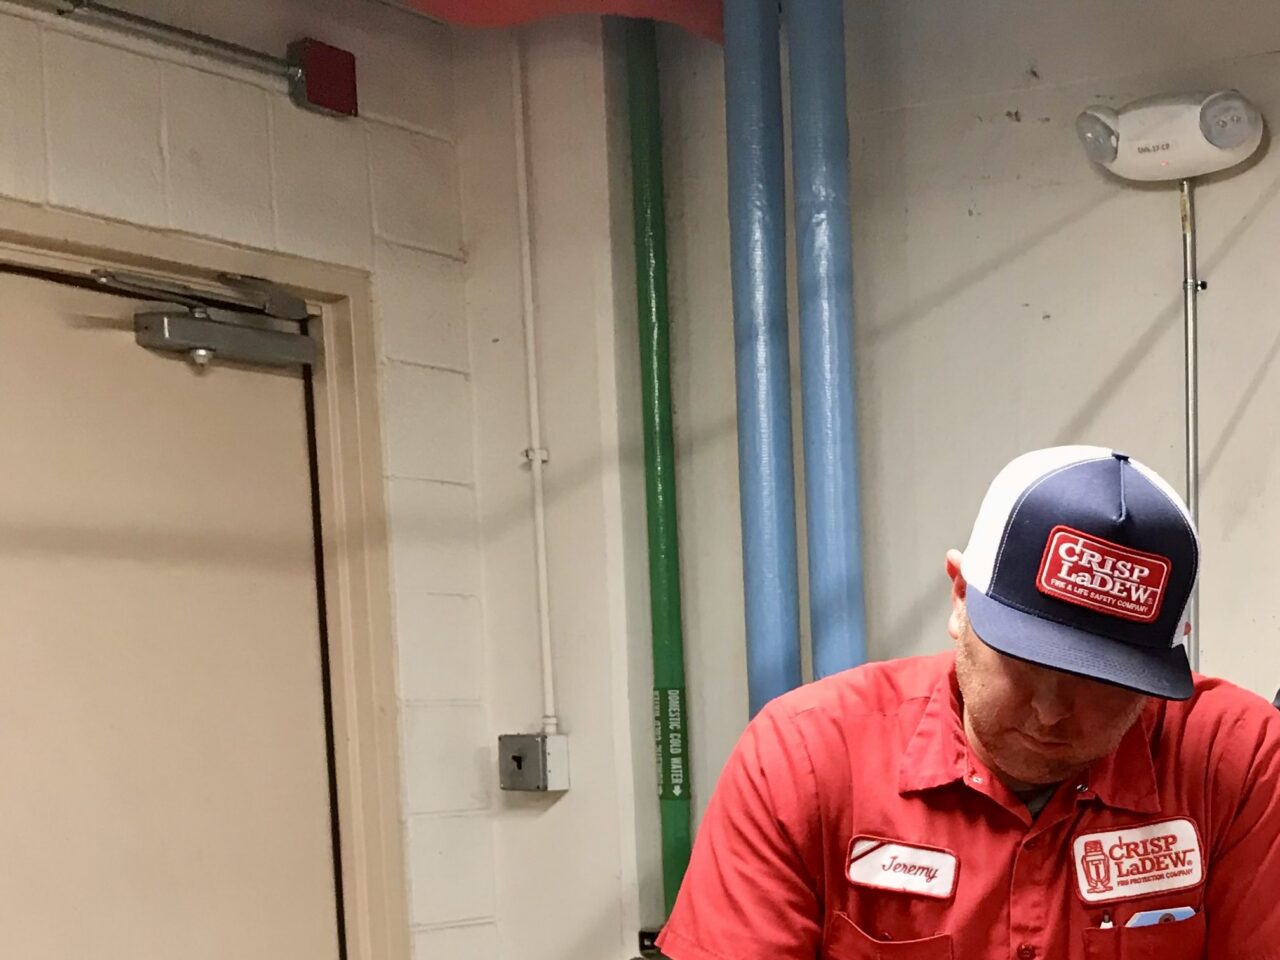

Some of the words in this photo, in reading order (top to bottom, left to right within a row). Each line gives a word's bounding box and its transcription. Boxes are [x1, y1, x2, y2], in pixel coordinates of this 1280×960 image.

[1058, 539, 1149, 582] CRISP
[1051, 578, 1065, 590] FIRE
[1073, 585, 1089, 597] LIFE
[1089, 591, 1117, 606] SAFETY
[1117, 599, 1149, 613] COMPANY
[667, 689, 681, 730] DOMESTIC
[669, 733, 682, 754] COLD
[671, 757, 683, 784] WATER
[1108, 834, 1178, 861] CRISP
[882, 856, 939, 883] Jeremy
[1130, 874, 1165, 885] PROTECTION
[1166, 868, 1193, 879] COMPANY
